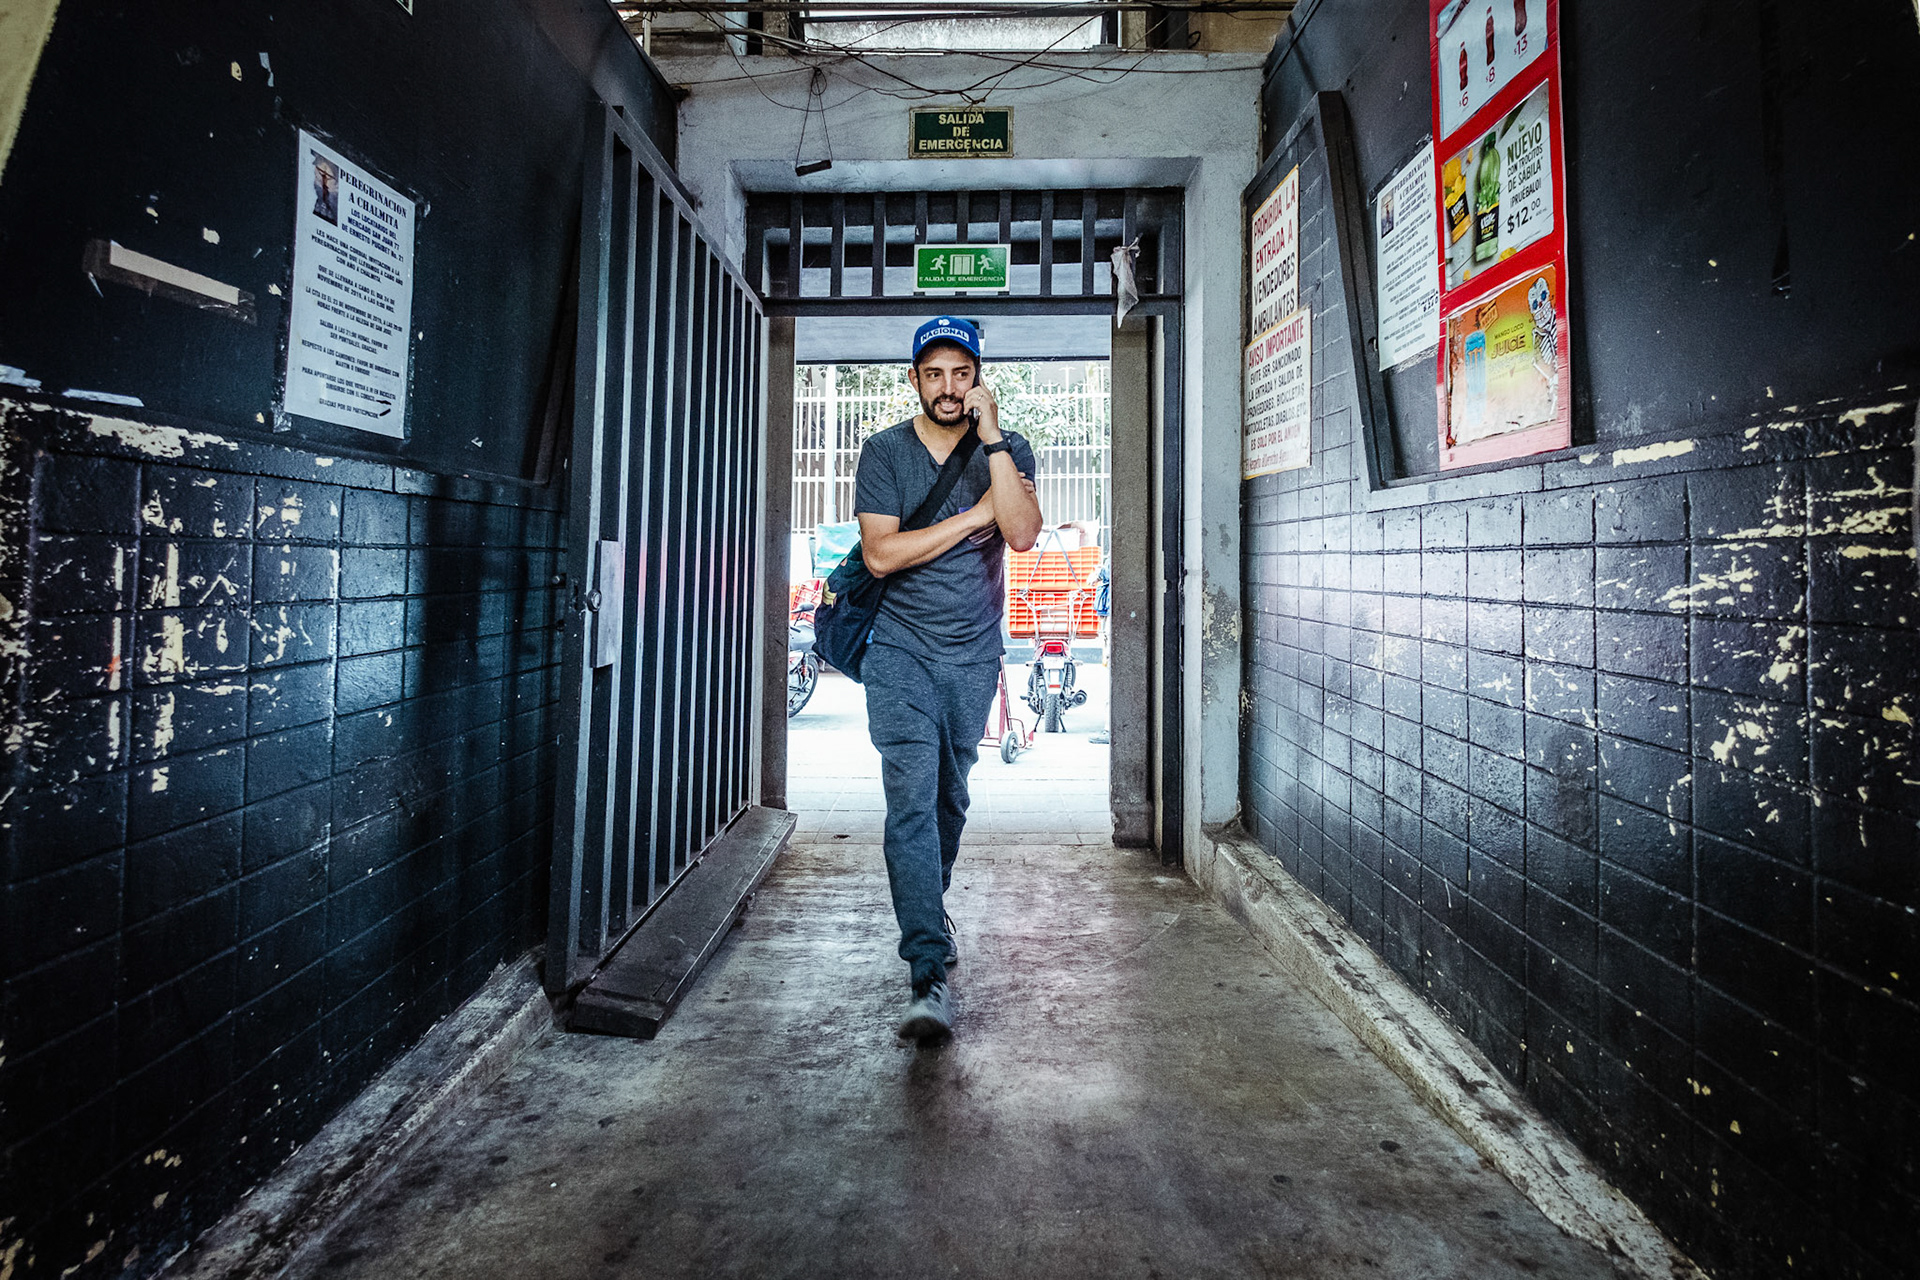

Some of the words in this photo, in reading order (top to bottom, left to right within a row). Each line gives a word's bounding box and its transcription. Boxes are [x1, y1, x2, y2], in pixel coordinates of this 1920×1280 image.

[1514, 33, 1528, 55] $13
[1486, 66, 1495, 82] $8
[1459, 91, 1468, 108] $6
[938, 114, 984, 124] SALIDA
[953, 126, 970, 137] DE
[919, 139, 1003, 150] EMERGENCIA
[1507, 122, 1542, 166] NUEVO
[1507, 162, 1518, 178] CON
[1519, 144, 1543, 171] TROCITOS
[340, 169, 406, 218] PEREGRINACION
[1508, 178, 1516, 192] DE
[349, 192, 354, 203] A
[357, 197, 398, 229] CHALMITA
[351, 209, 360, 218] LOS
[362, 215, 388, 234] LOCATARIOS
[1254, 193, 1282, 244] PROHIBIDA
[1286, 180, 1295, 210] LA
[341, 223, 348, 232] DE
[349, 228, 370, 244] ERNESTO
[348, 217, 371, 234] MERCADO
[372, 230, 381, 240] SAN
[382, 236, 393, 246] JUAN
[1256, 227, 1285, 273] ENTRADA
[1288, 219, 1293, 243] A
[1254, 252, 1295, 306] VENDEDORES
[1254, 288, 1295, 338] AMBULANTES
[922, 328, 968, 341] NACIONAL
[1248, 343, 1263, 369] AVISO
[1266, 317, 1303, 358] IMPORTANTE
[1494, 328, 1510, 340] MANGO
[1511, 322, 1524, 332] LOCO
[1491, 334, 1526, 359] JUICE
[1250, 369, 1261, 385] EVITE
[1272, 346, 1301, 373] SANCIONADO
[1248, 390, 1254, 402] LA
[1255, 382, 1272, 399] ENTRADA
[1278, 369, 1294, 387] SALIDA
[1296, 364, 1302, 379] DE
